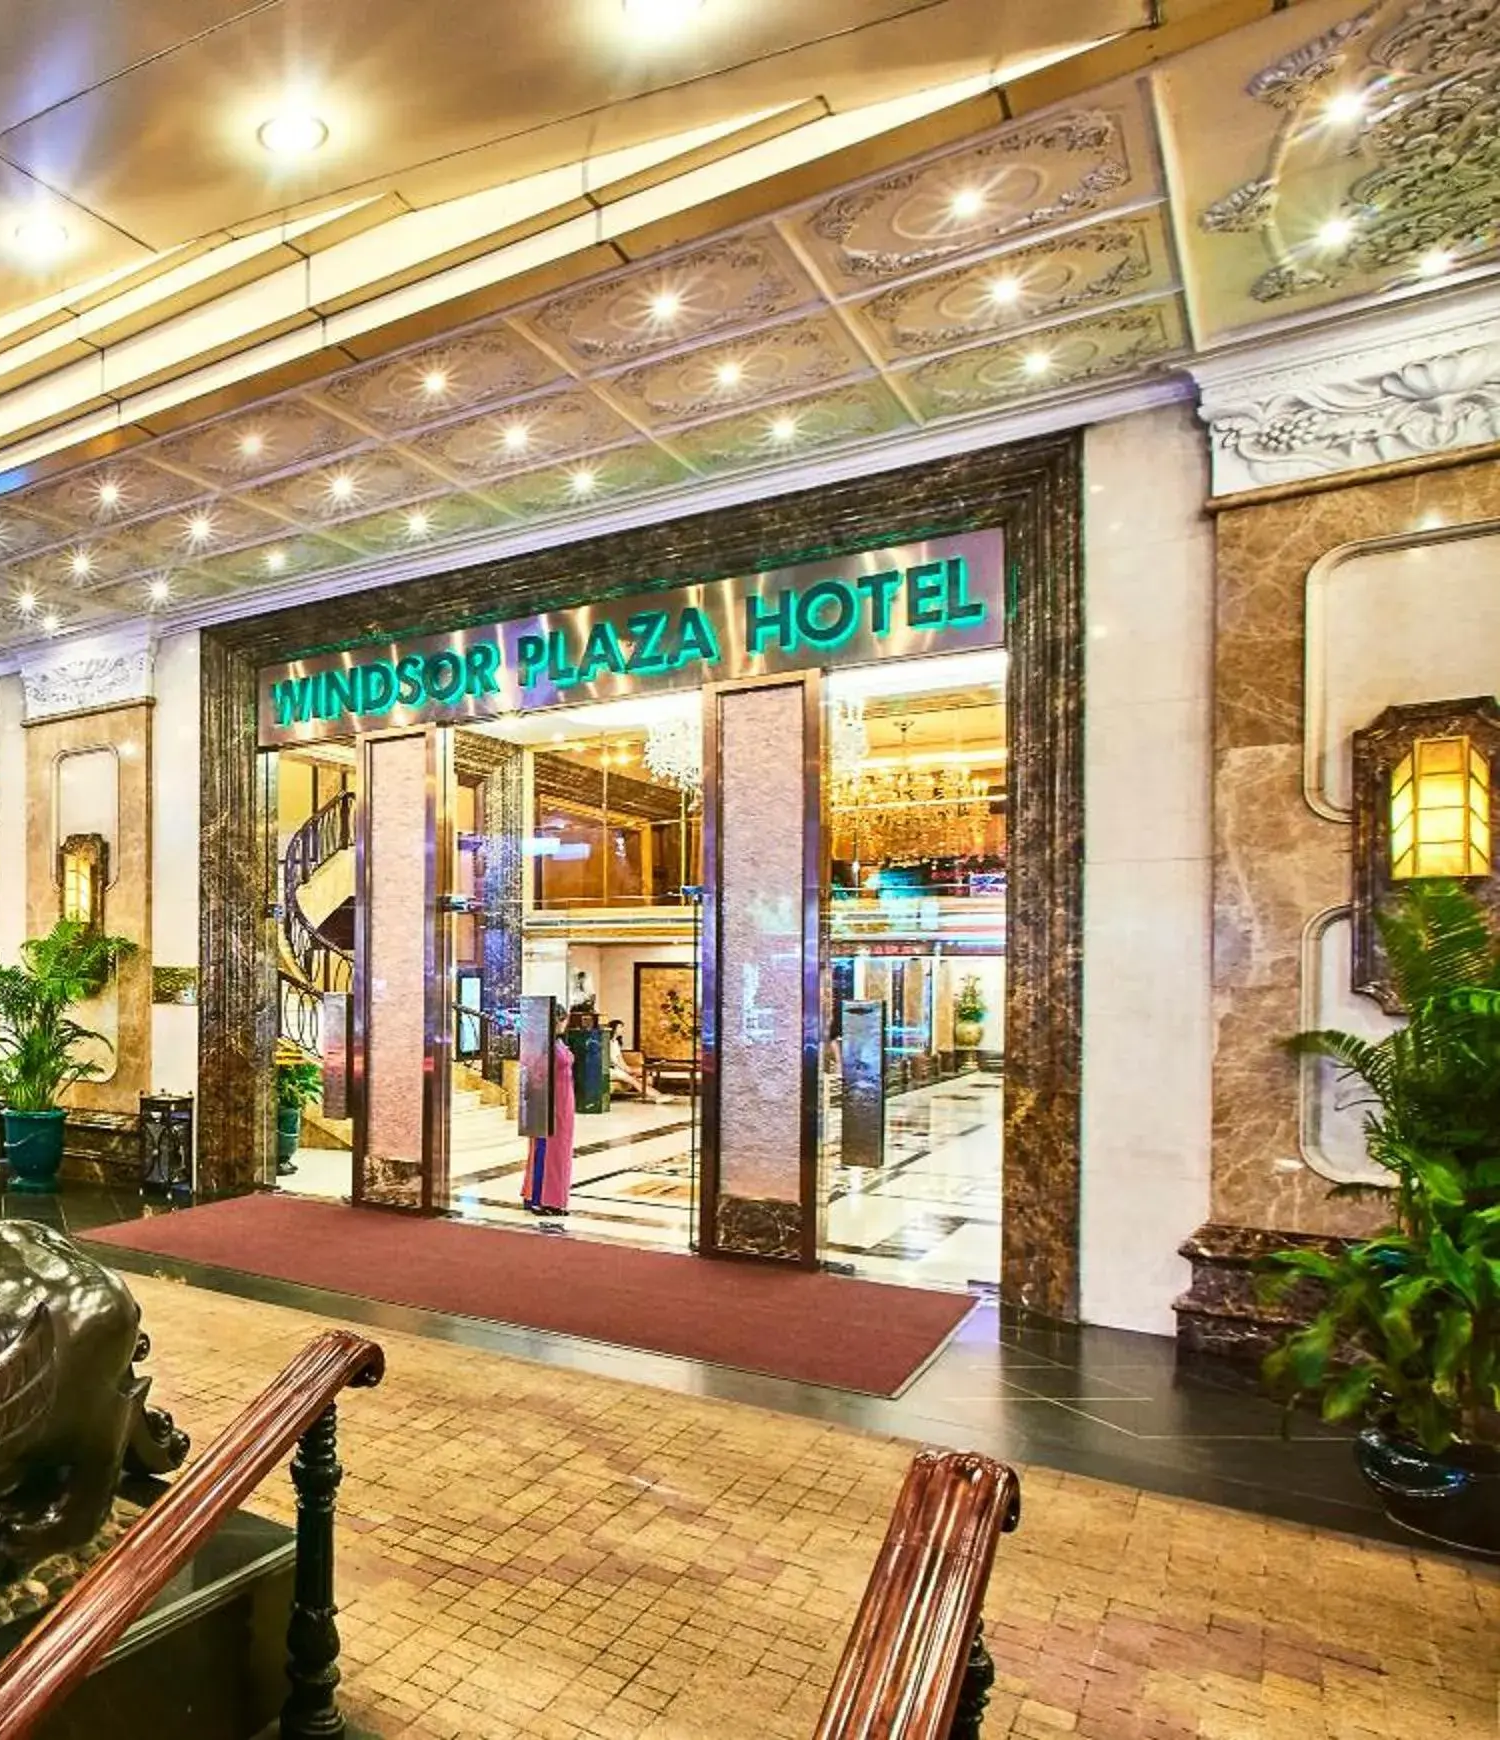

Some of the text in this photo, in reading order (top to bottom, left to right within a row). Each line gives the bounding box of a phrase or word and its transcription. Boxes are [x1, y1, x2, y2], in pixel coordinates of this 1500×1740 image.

[269, 555, 984, 728] WINDSOR PLAZA HOTEL
